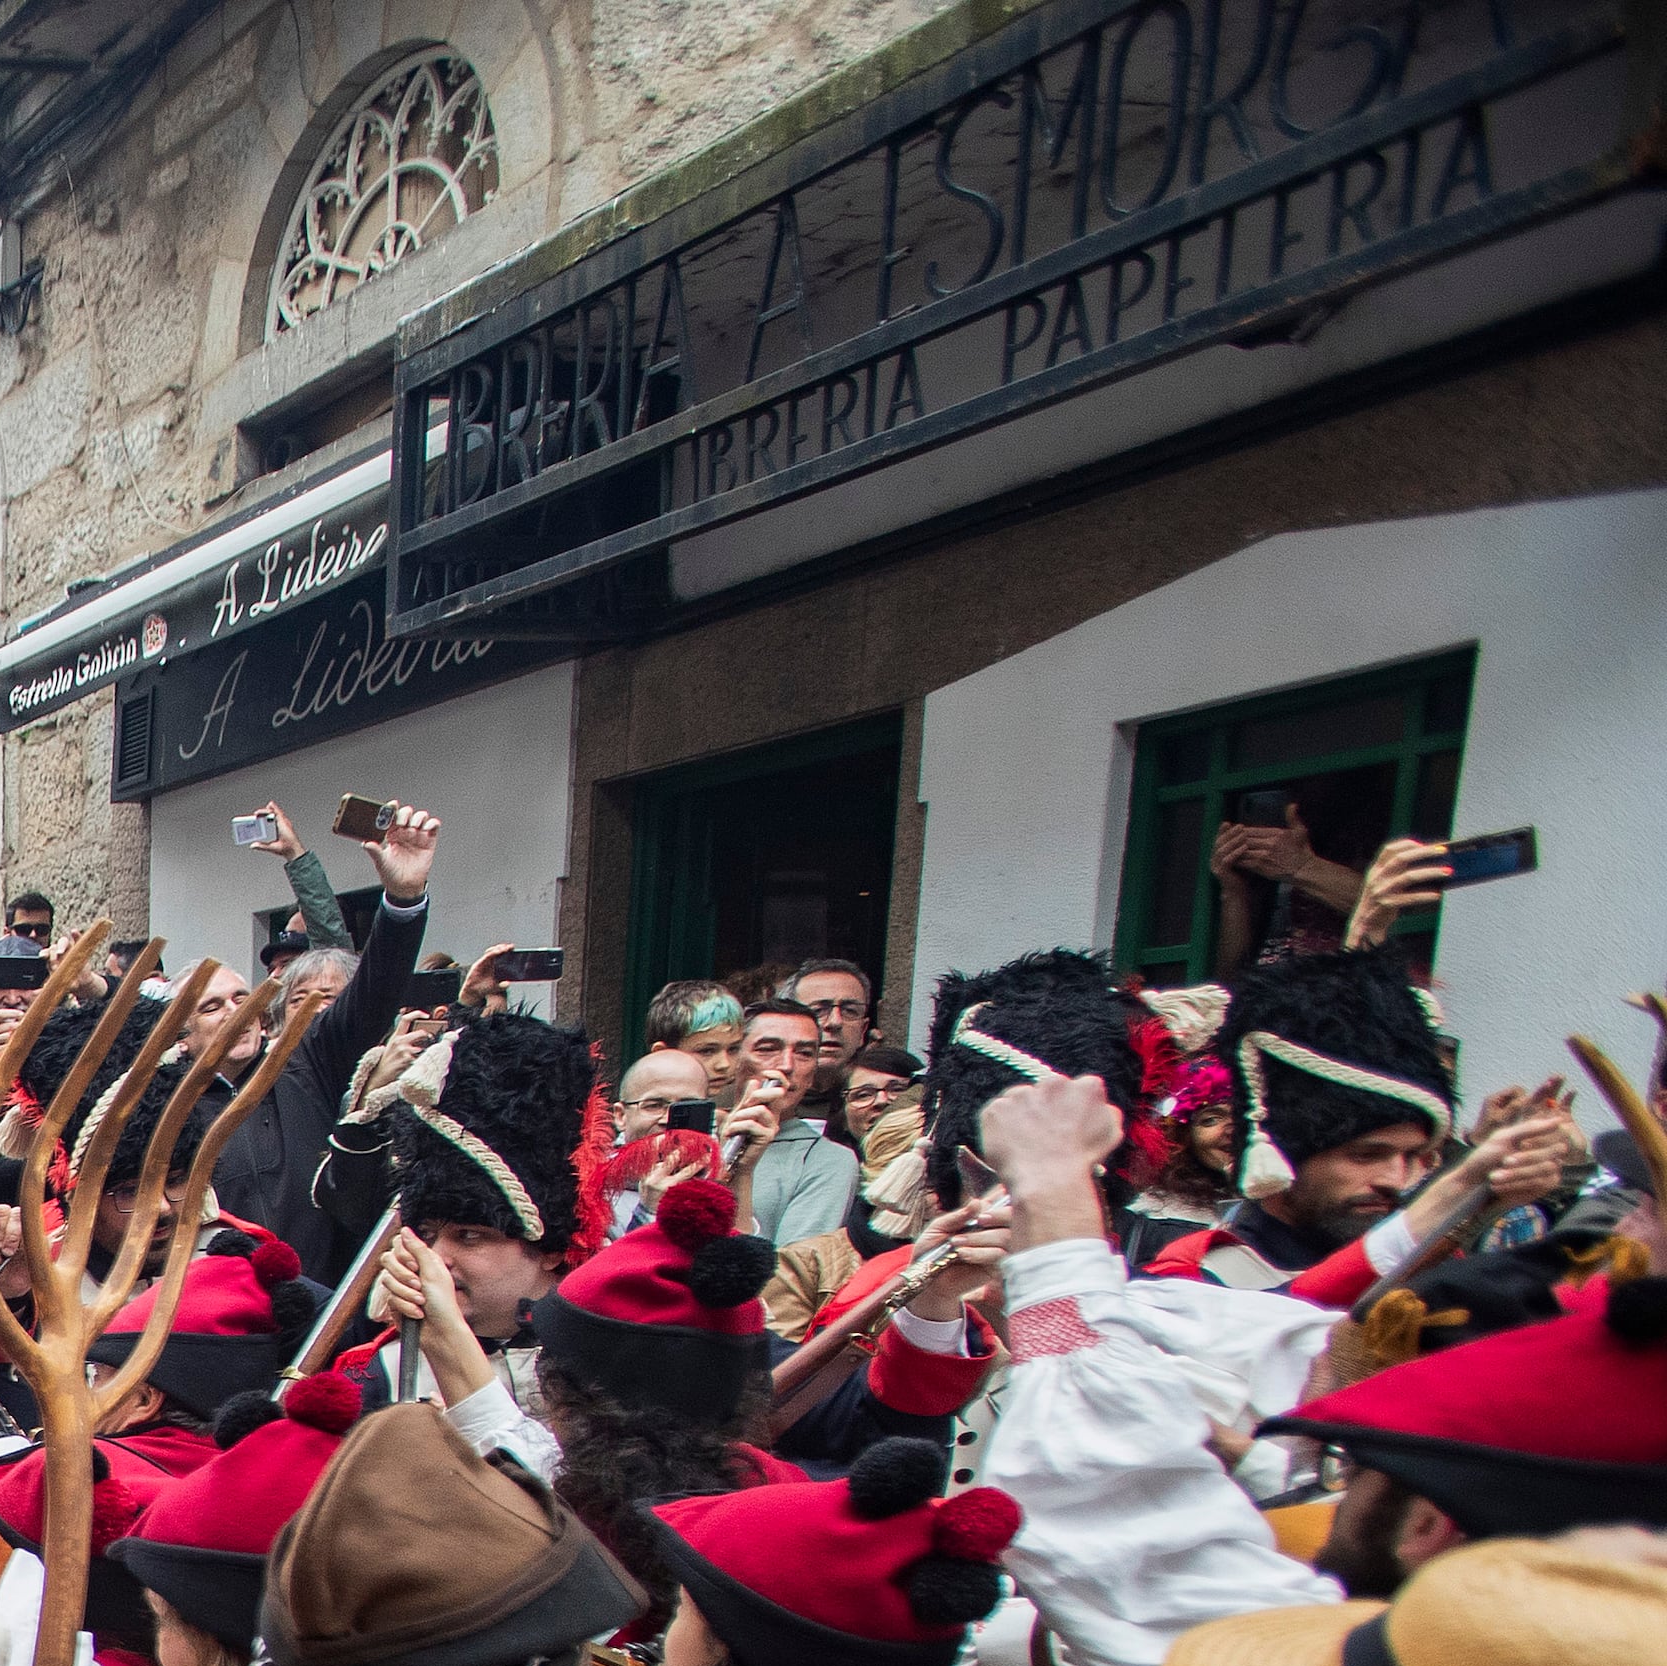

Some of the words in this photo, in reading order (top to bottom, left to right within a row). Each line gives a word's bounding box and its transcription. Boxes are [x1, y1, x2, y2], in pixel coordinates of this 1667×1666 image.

[745, 194, 813, 385] A
[873, 0, 1517, 325] ESMORG
[660, 347, 925, 514] LIBRERIA
[1000, 104, 1494, 385] PAPELERIA
[210, 561, 244, 637] A
[8, 666, 74, 716] Estrella
[75, 635, 137, 687] Galicia
[178, 649, 249, 760] A
